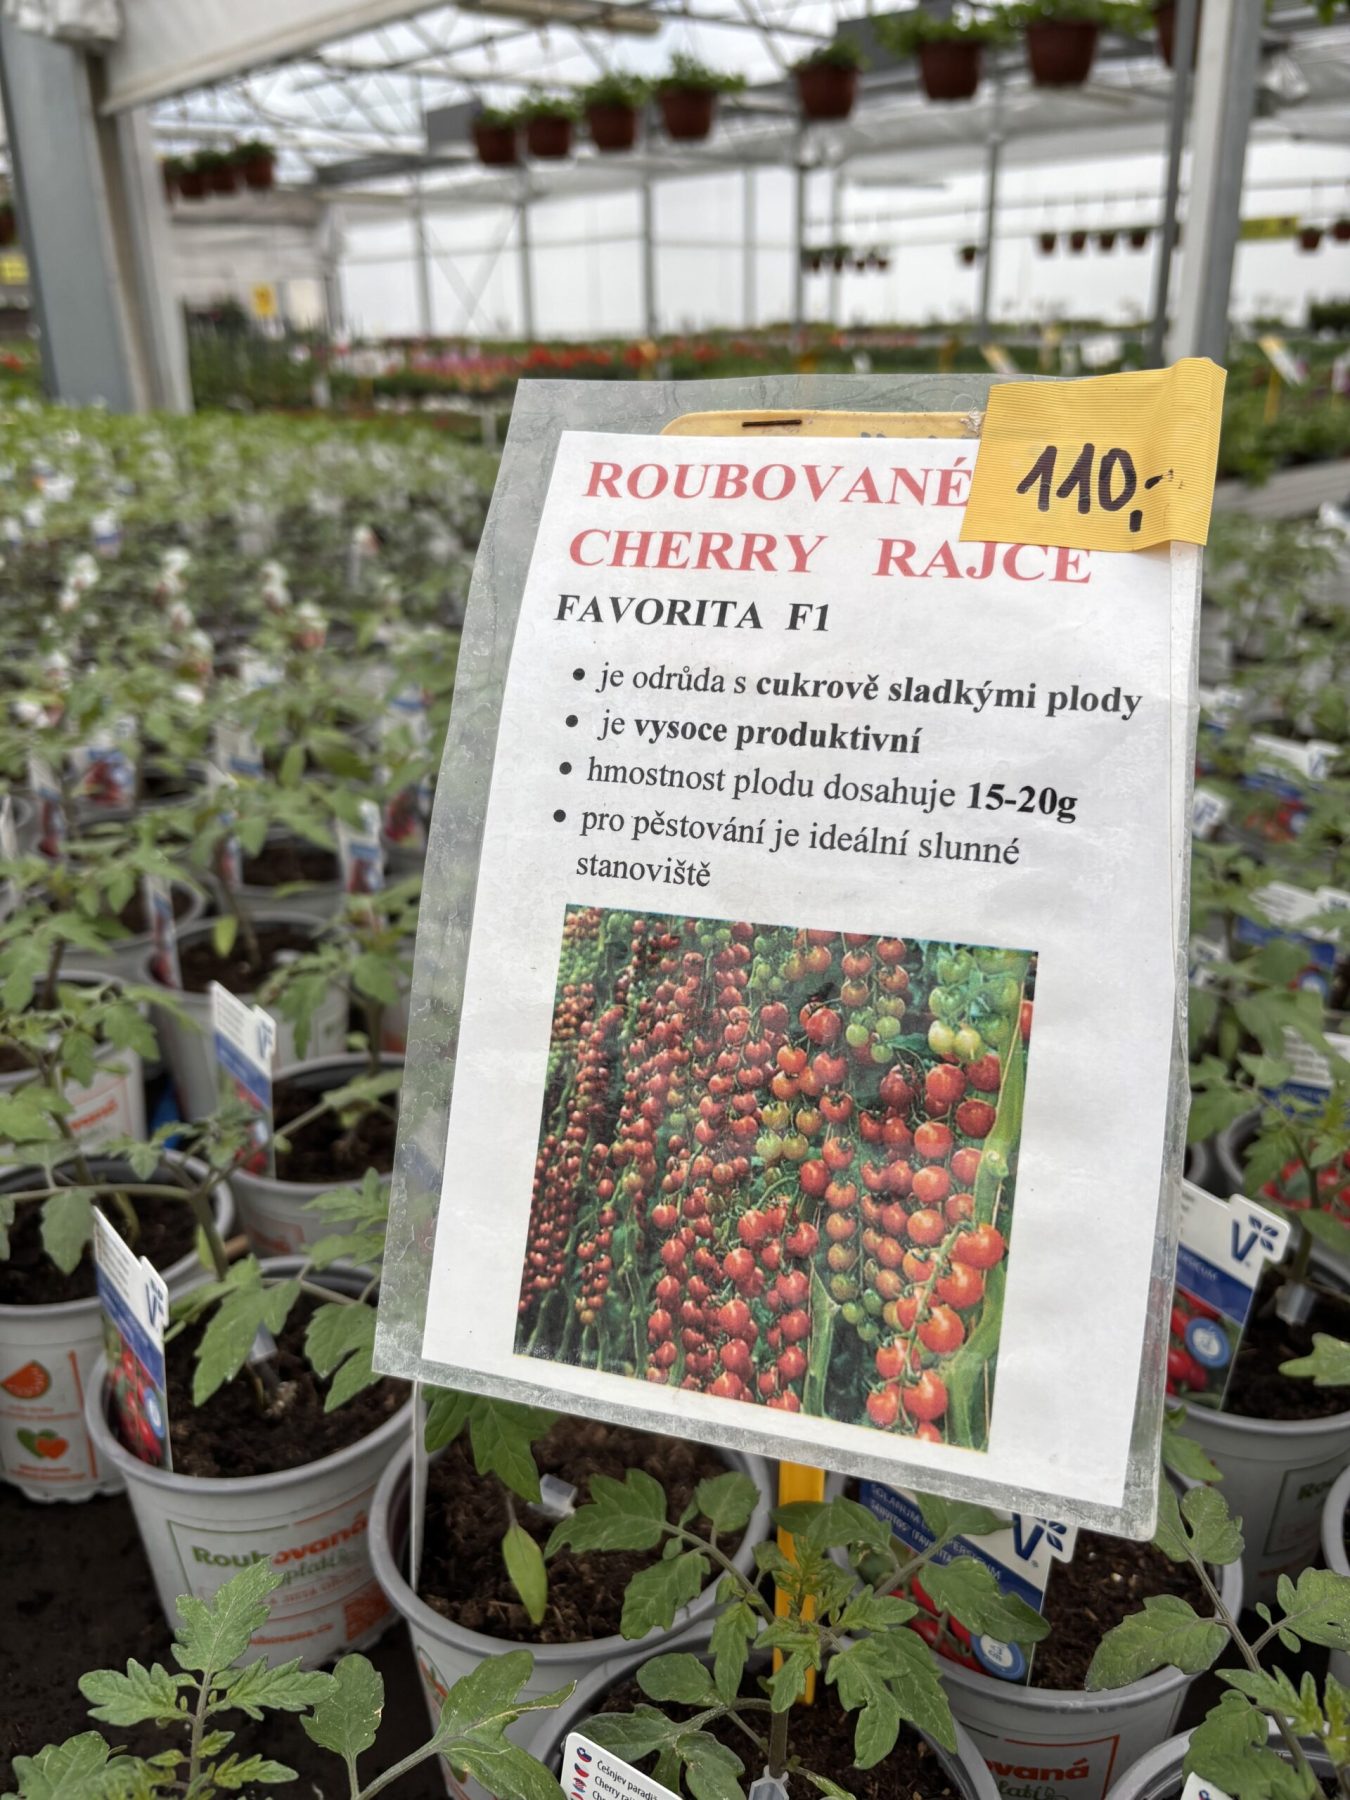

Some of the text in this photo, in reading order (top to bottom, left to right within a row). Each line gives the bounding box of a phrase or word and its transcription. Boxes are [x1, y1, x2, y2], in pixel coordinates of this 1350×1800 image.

[582, 456, 972, 507] ROUBOVANÉ
[569, 529, 828, 573] CHERRY
[553, 594, 830, 632] FAVORITA F1
[595, 661, 1144, 721] je odrůda s cukrově sladkými plody
[597, 709, 923, 754] je vysoce produktivní
[587, 756, 1078, 824] hmostnost plodu dosahuje 15-20g
[579, 810, 1020, 865] pro pěstování je ideální slunné
[576, 854, 711, 887] stanoviště
[594, 1775, 621, 1798] Cherry
